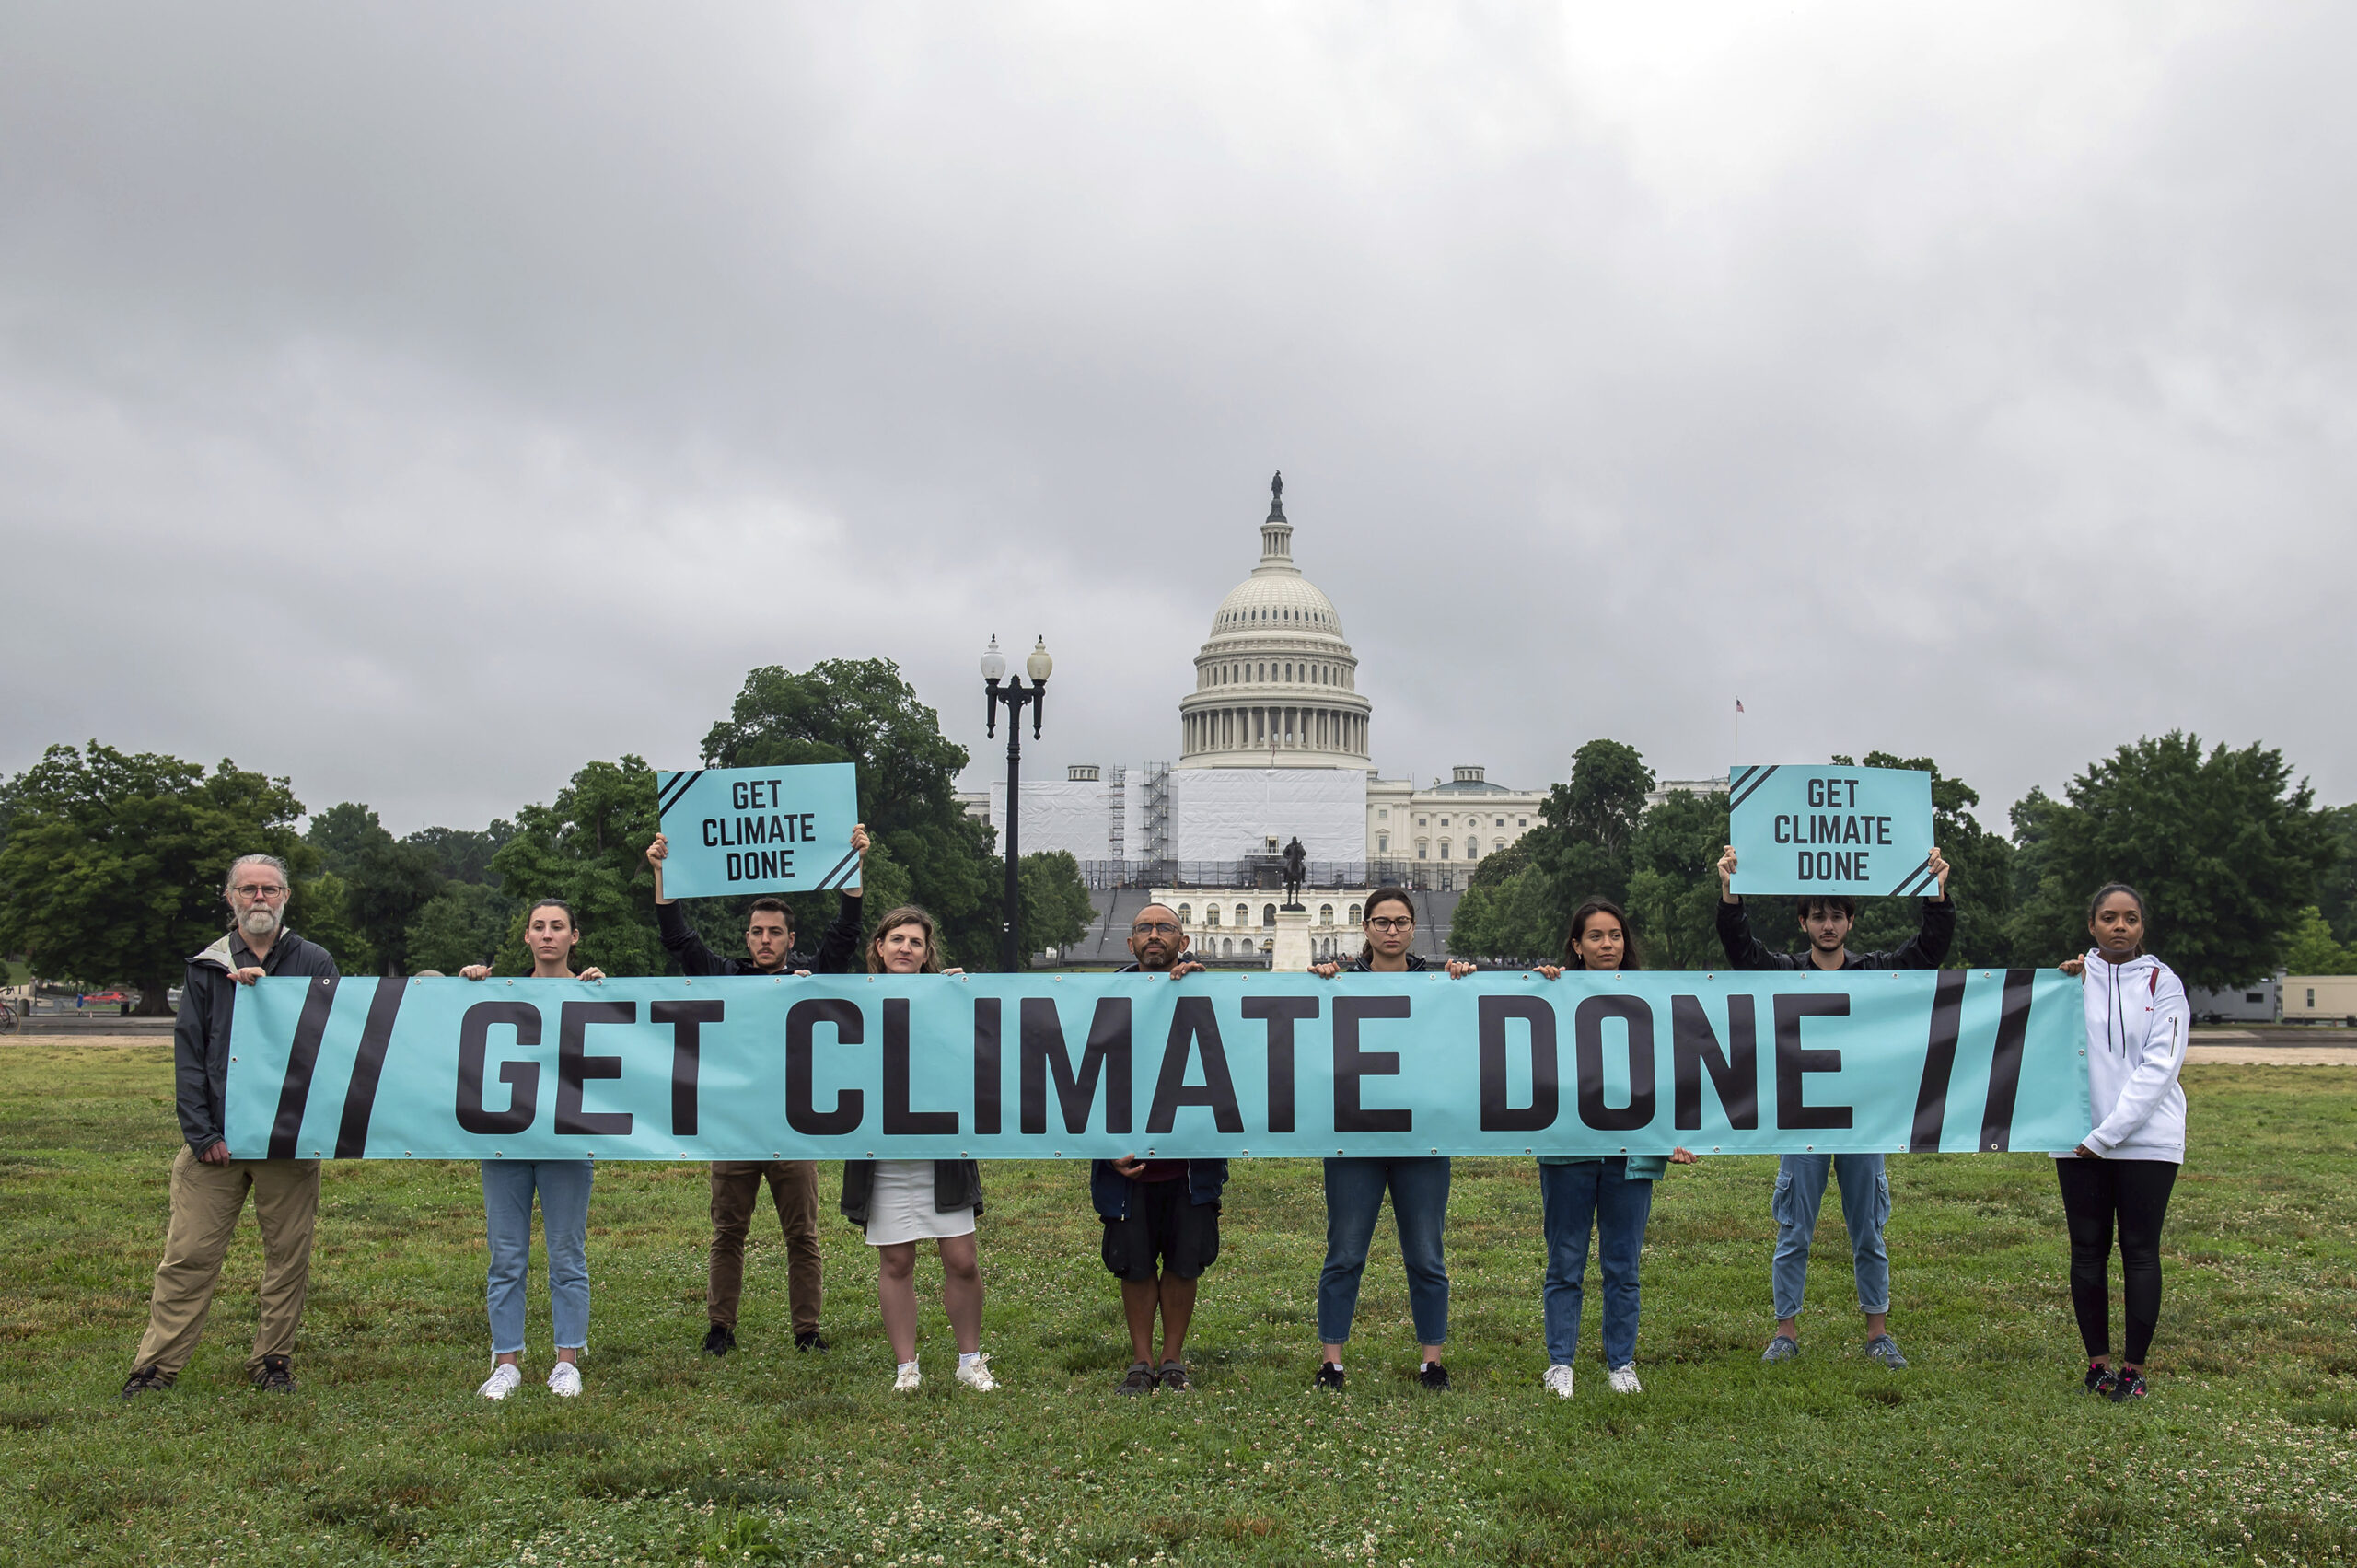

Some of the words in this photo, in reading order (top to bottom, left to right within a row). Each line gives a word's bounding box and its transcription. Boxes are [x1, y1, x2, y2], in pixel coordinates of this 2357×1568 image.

[732, 779, 782, 809] GET
[1808, 778, 1859, 808] GET
[702, 813, 816, 847] CLIMATE
[1774, 814, 1892, 845] CLIMATE
[726, 849, 795, 881] DONE
[1798, 851, 1870, 881] DONE
[456, 999, 725, 1136] GET
[785, 995, 1413, 1136] CLIMATE
[1479, 993, 1853, 1132] DONE
